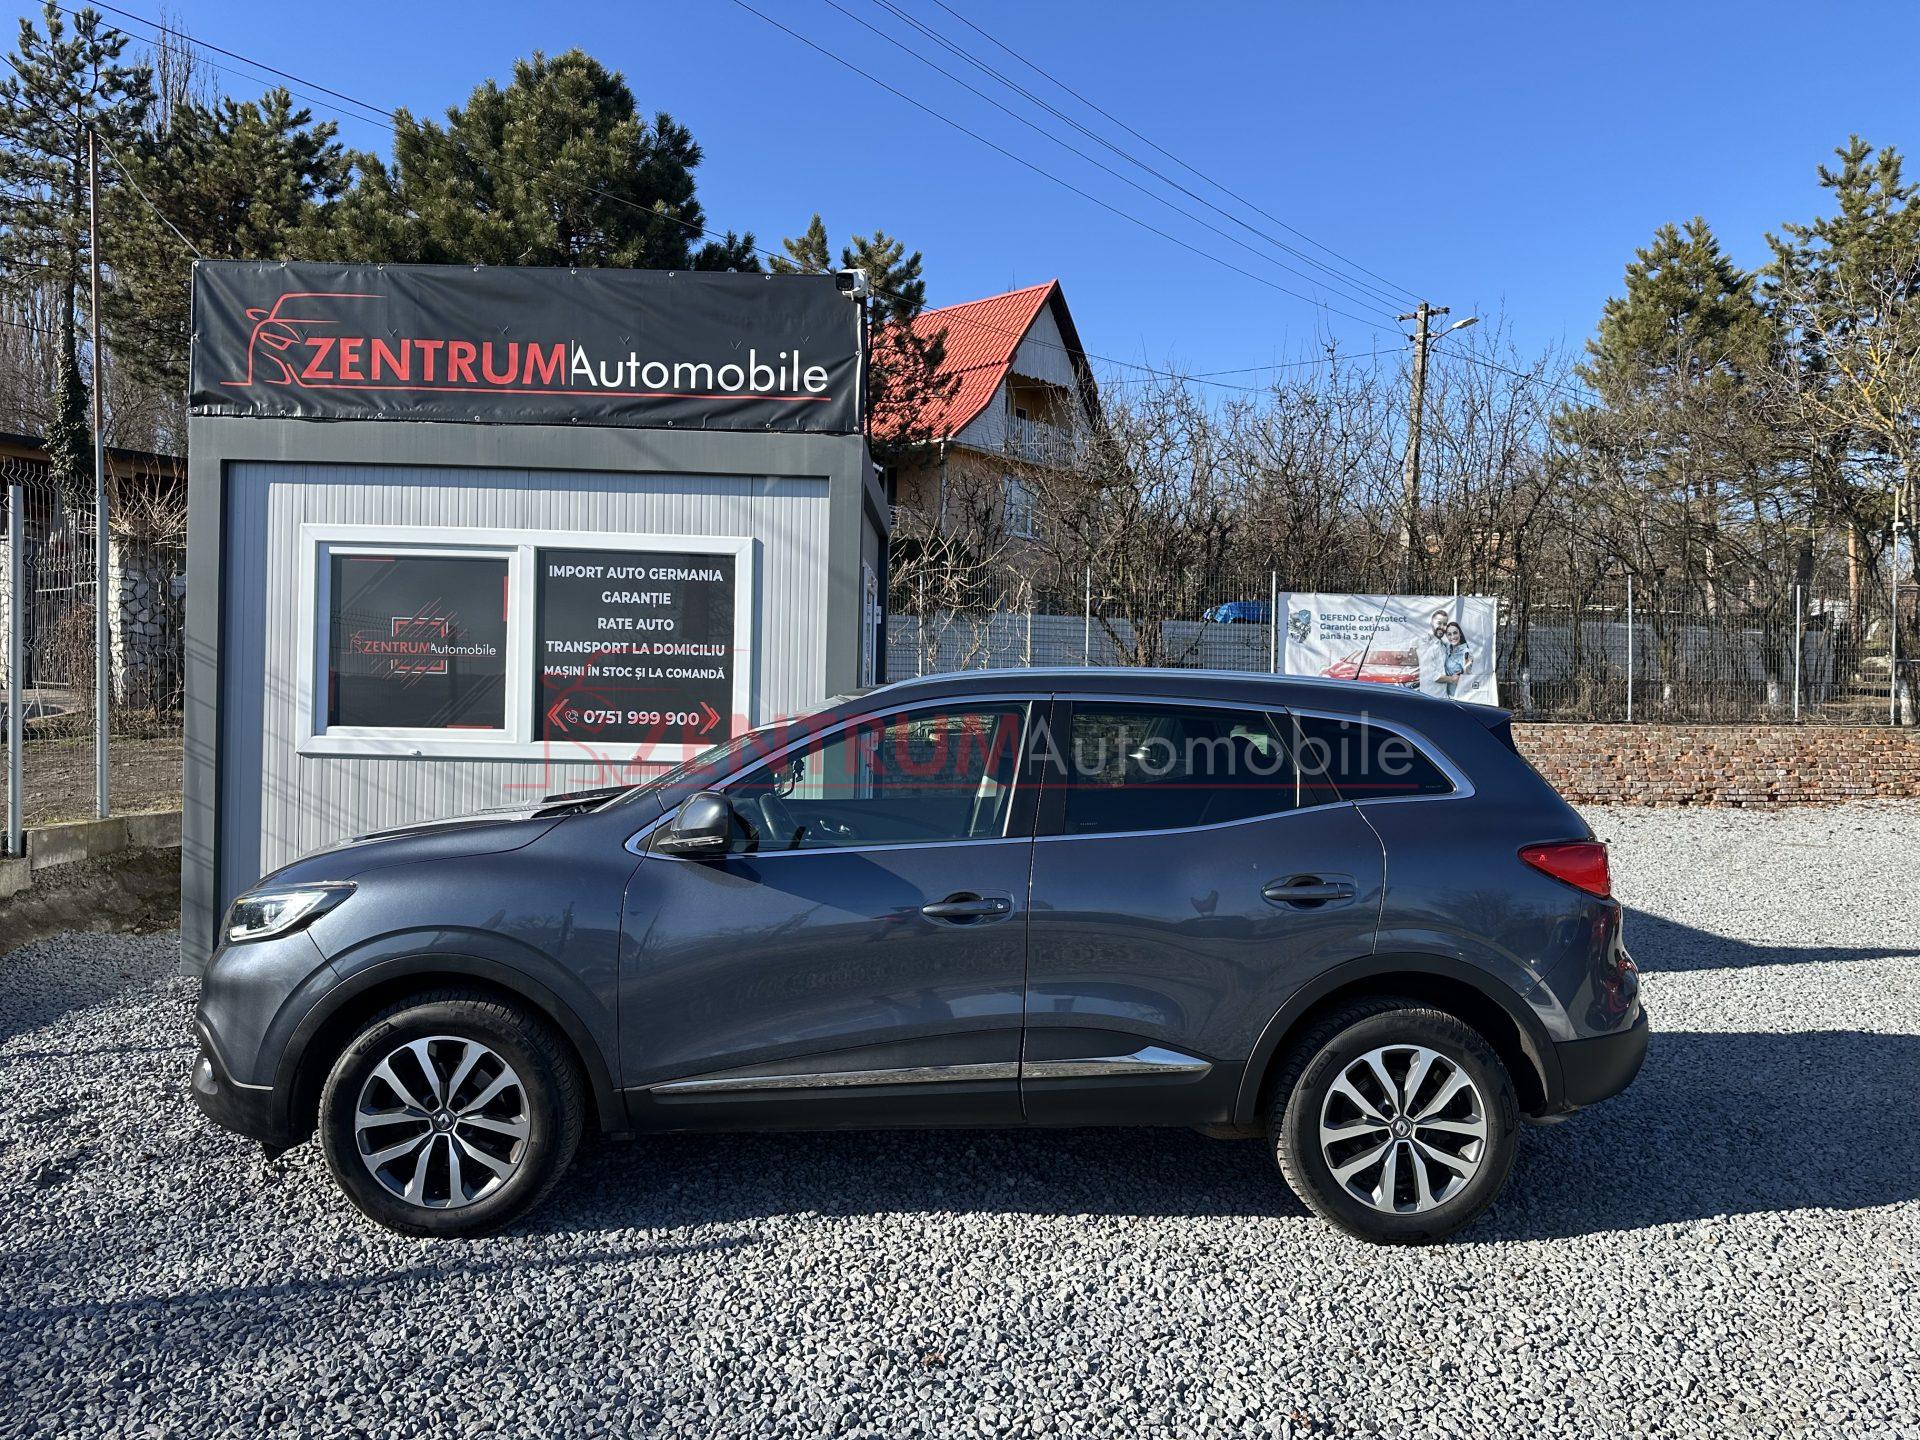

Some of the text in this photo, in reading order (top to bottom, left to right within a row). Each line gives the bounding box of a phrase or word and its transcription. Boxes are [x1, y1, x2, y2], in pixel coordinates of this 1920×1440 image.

[301, 336, 830, 394] ZENTRUM Automobile
[549, 565, 724, 582] IMPORT AUTO GERMANIA
[601, 591, 672, 608] GARANȚIE
[597, 617, 675, 631] RATE AUTO
[1320, 614, 1408, 623] DEFEND Car Protect
[1320, 623, 1357, 633] Garanție
[363, 640, 497, 656] ZENTRUM Automobile
[546, 640, 726, 657] TRANSPORT LA DOMICILIU
[544, 663, 726, 681] MAȘINI ÎN STOC ȘI LA COMANDĂ
[583, 710, 700, 726] 0751 999 900
